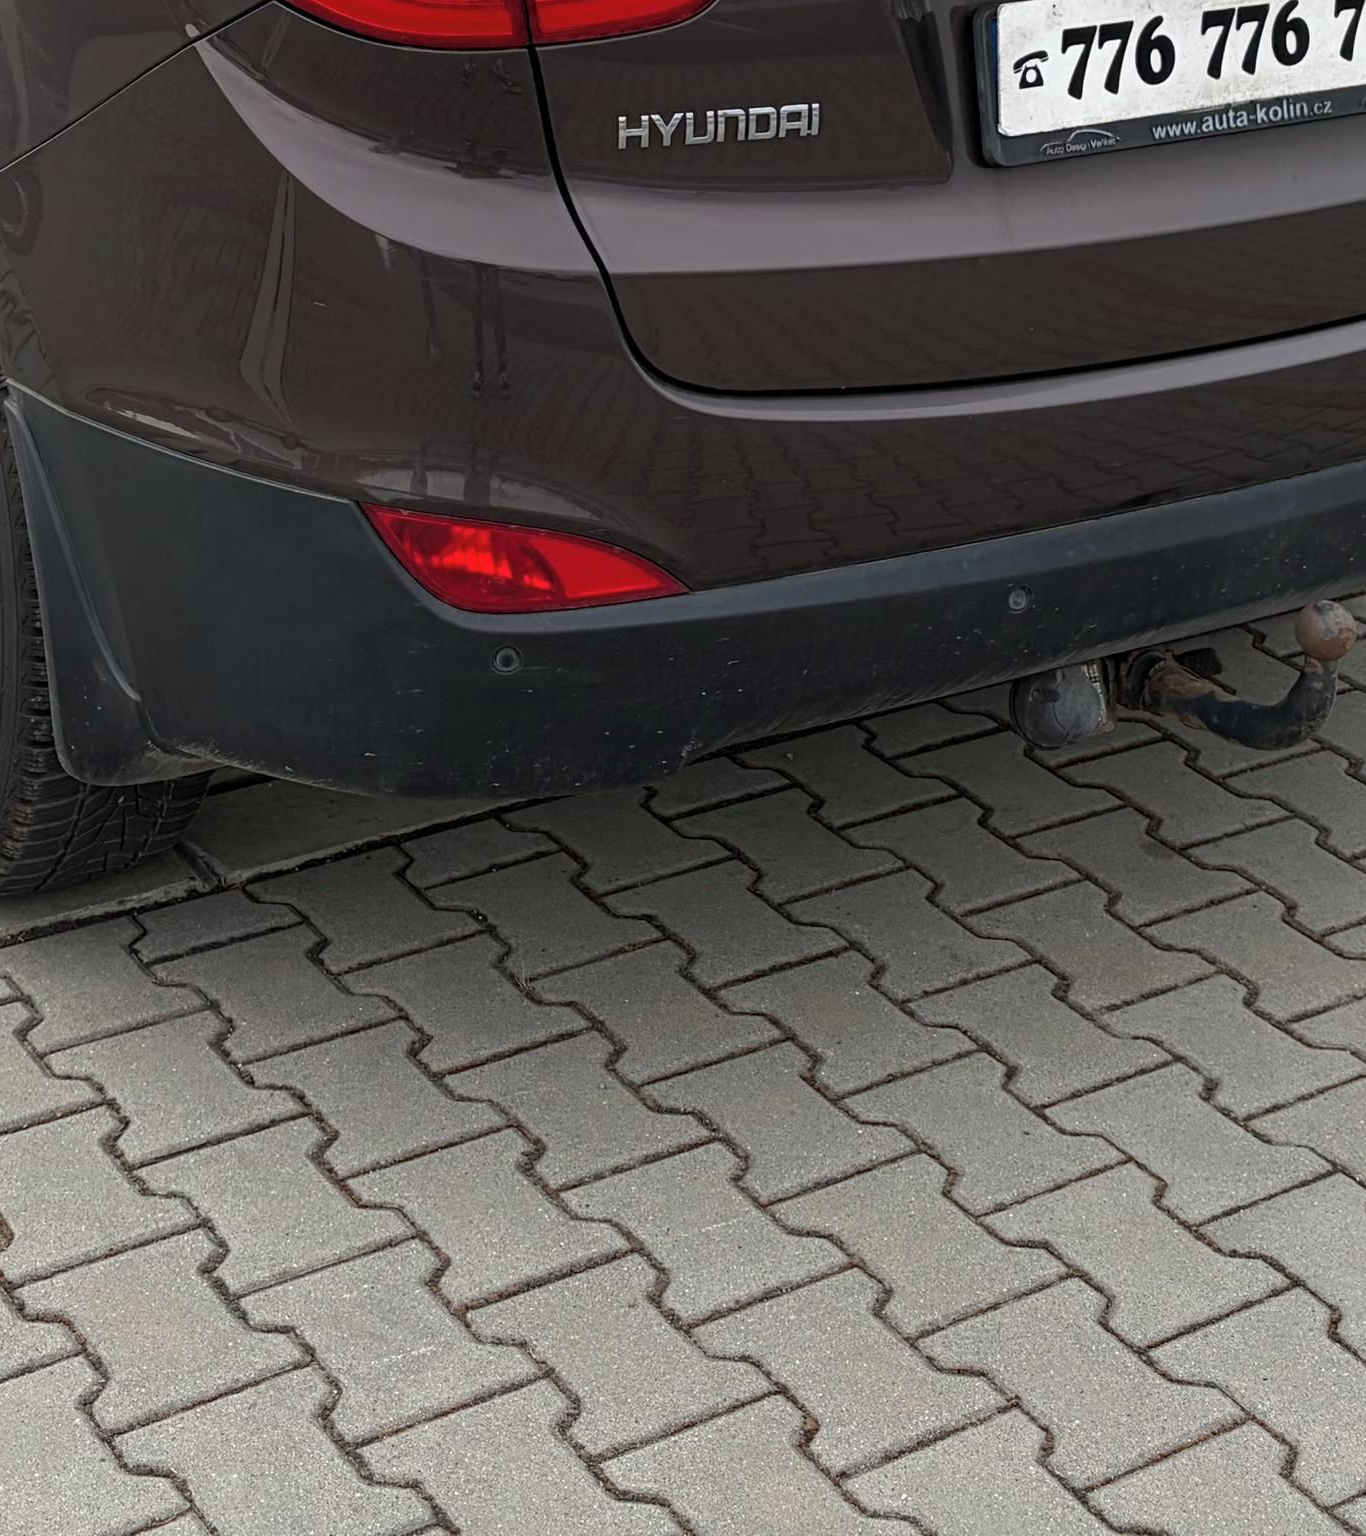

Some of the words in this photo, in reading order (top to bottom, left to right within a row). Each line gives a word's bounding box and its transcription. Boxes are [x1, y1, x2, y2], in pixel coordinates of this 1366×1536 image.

[1061, 15, 1175, 100] 776
[618, 102, 820, 150] HYUNDAI
[1152, 99, 1333, 141] www.auta-kolin.cz
